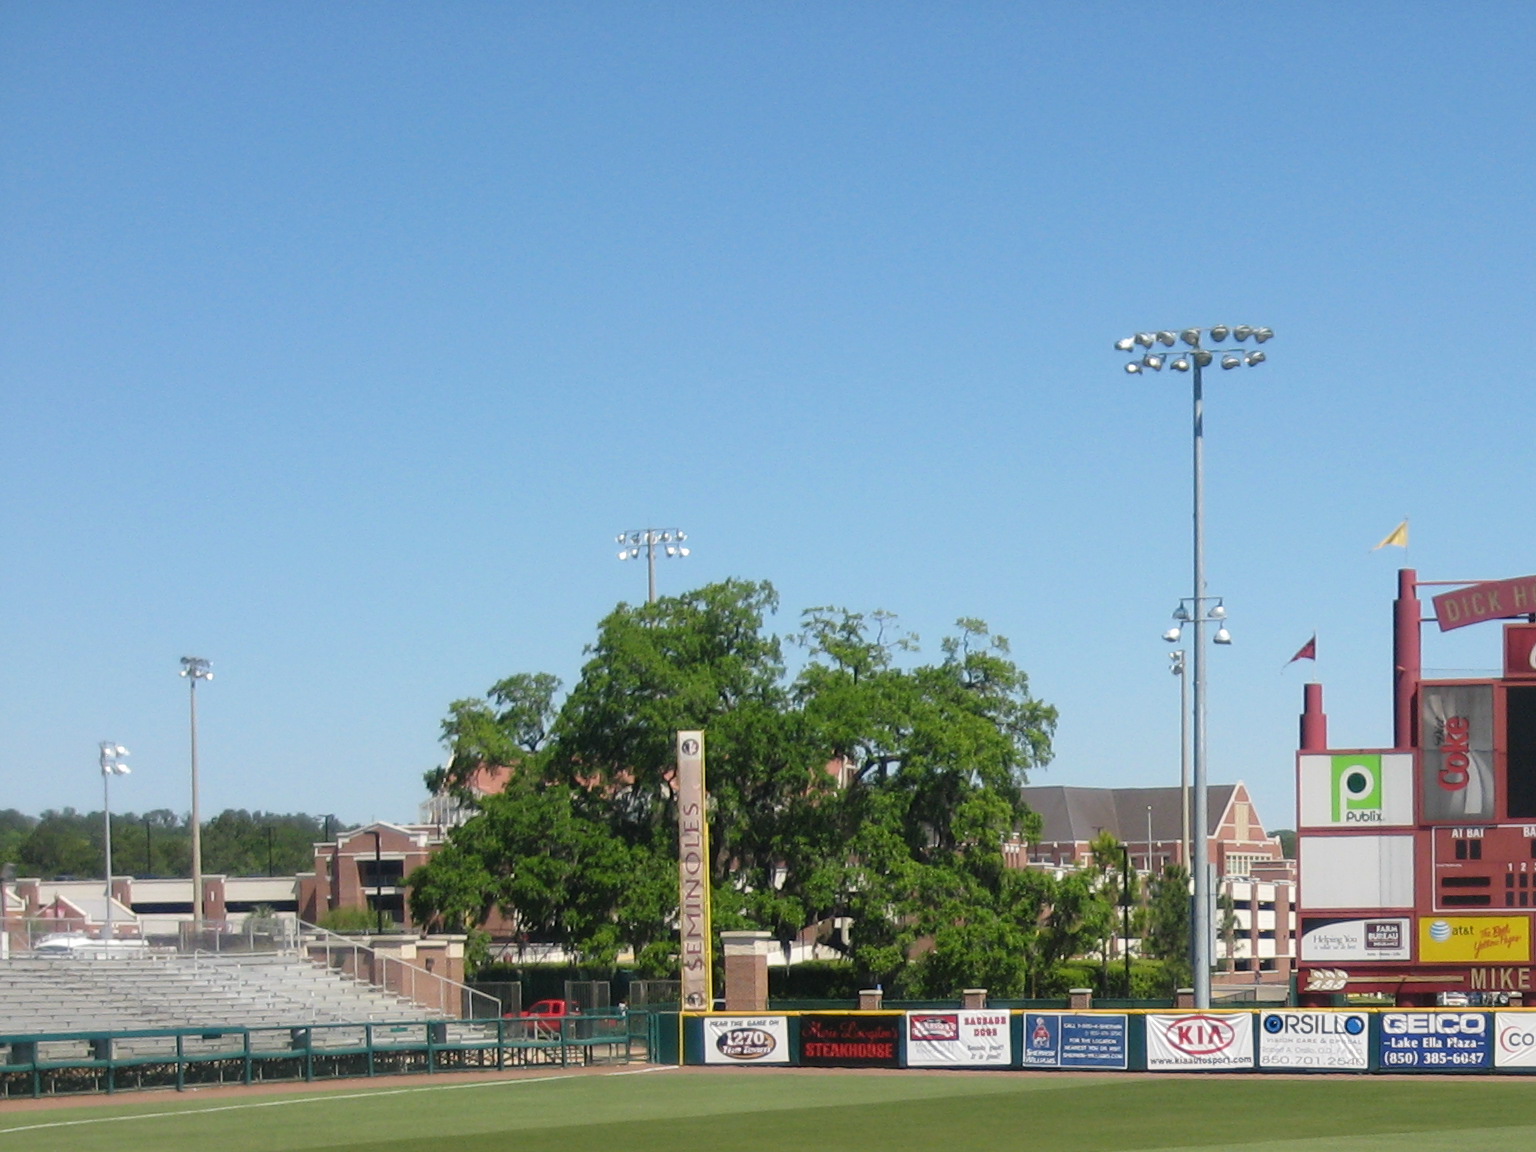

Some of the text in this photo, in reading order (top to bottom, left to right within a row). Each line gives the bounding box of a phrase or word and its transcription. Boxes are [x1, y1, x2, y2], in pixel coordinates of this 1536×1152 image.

[1444, 589, 1502, 623] DICK
[1437, 715, 1470, 792] Coke
[1345, 811, 1383, 823] Publix
[1451, 828, 1485, 838] AT BAT
[1507, 862, 1514, 871] 1
[1520, 862, 1528, 871] 2
[683, 801, 704, 971] SEMINOLES
[1375, 924, 1398, 933] FARM
[1451, 925, 1475, 936] at&t
[1313, 934, 1343, 946] Helping
[1367, 932, 1399, 941] BUREAU
[1470, 967, 1532, 990] MIKE
[964, 1016, 1007, 1026] SAUSAGE
[1263, 1014, 1365, 1035] ORSILLO
[1382, 1013, 1486, 1034] GEICO
[726, 1031, 766, 1046] 1270
[973, 1028, 998, 1037] DOGS
[1177, 1025, 1225, 1045] KIA
[1422, 1037, 1443, 1048] Ella
[804, 1042, 894, 1058] STEAKHOUSE
[1384, 1052, 1418, 1066] (850)
